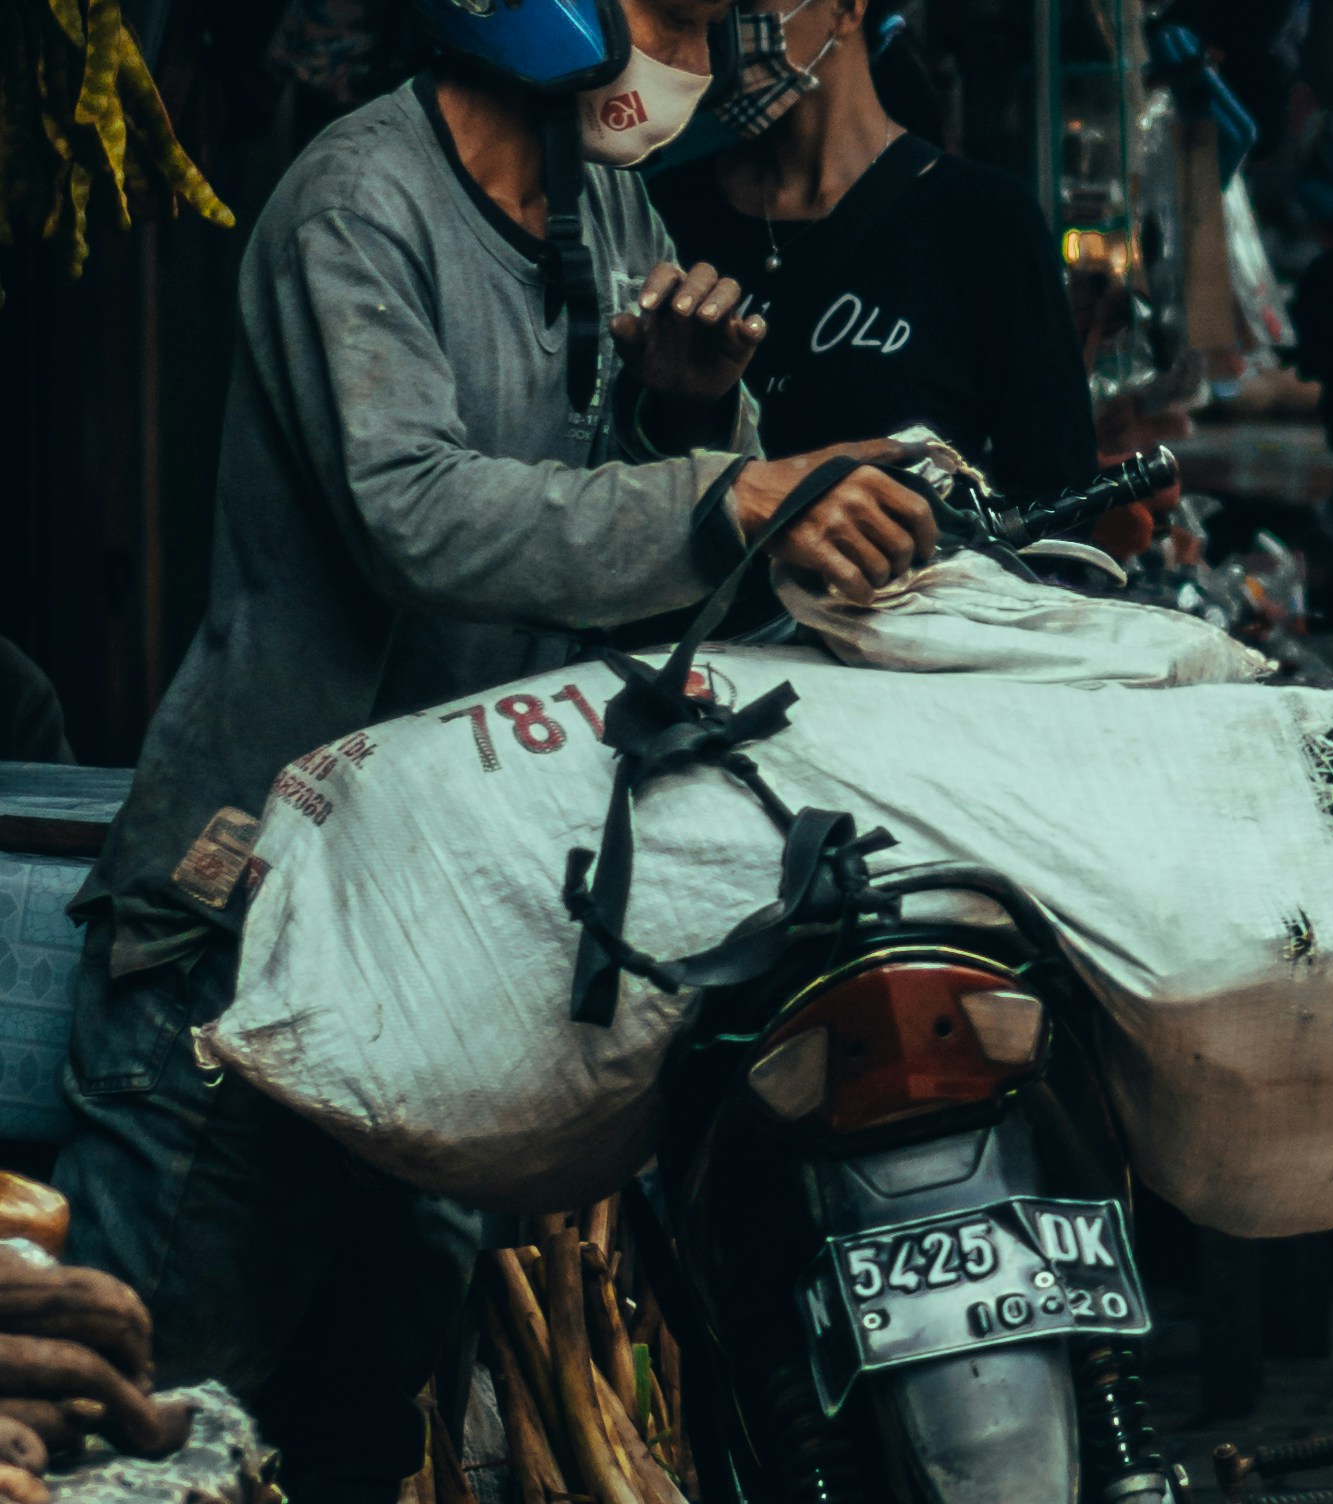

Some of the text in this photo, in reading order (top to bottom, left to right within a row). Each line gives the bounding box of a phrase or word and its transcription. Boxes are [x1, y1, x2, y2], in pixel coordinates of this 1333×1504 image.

[811, 293, 911, 353] OLD
[849, 1221, 998, 1298] 5425
[1035, 1212, 1115, 1268] DK
